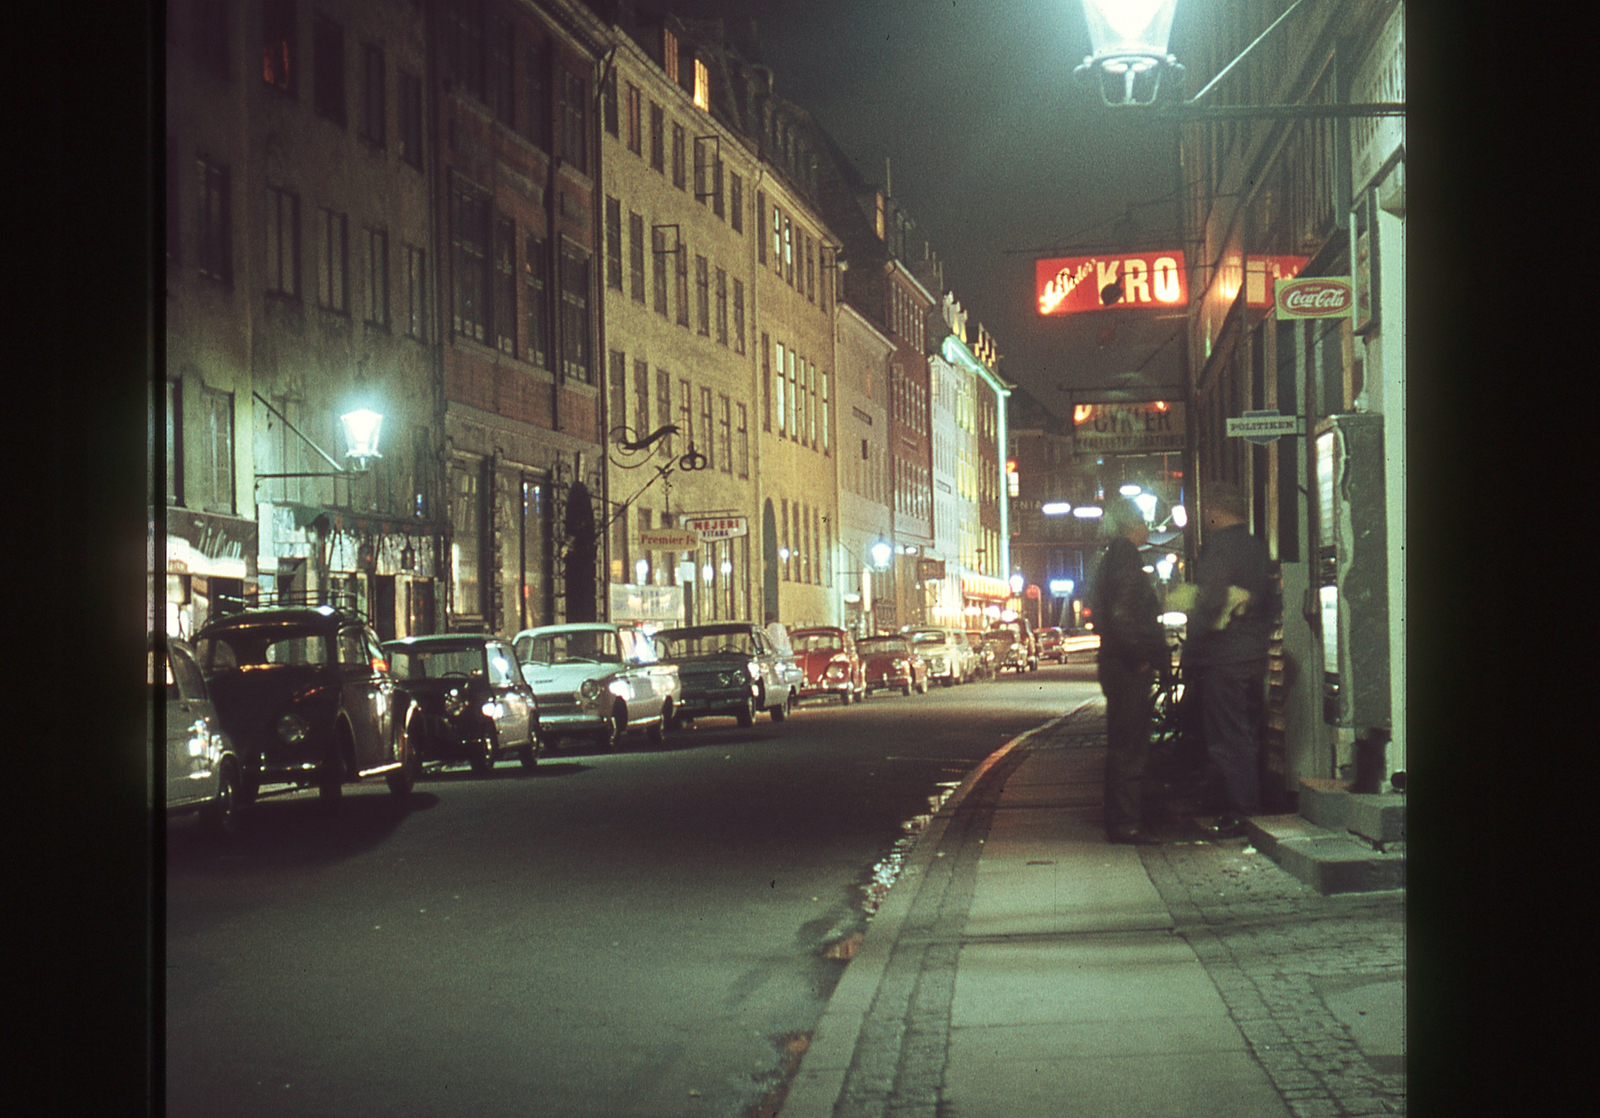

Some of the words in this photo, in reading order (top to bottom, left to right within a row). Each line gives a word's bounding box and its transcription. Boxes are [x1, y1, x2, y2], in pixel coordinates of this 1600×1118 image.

[1097, 257, 1180, 305] KRO
[1230, 421, 1294, 432] POLITIKEN
[694, 520, 740, 530] MEJERI
[641, 535, 683, 544] Premier
